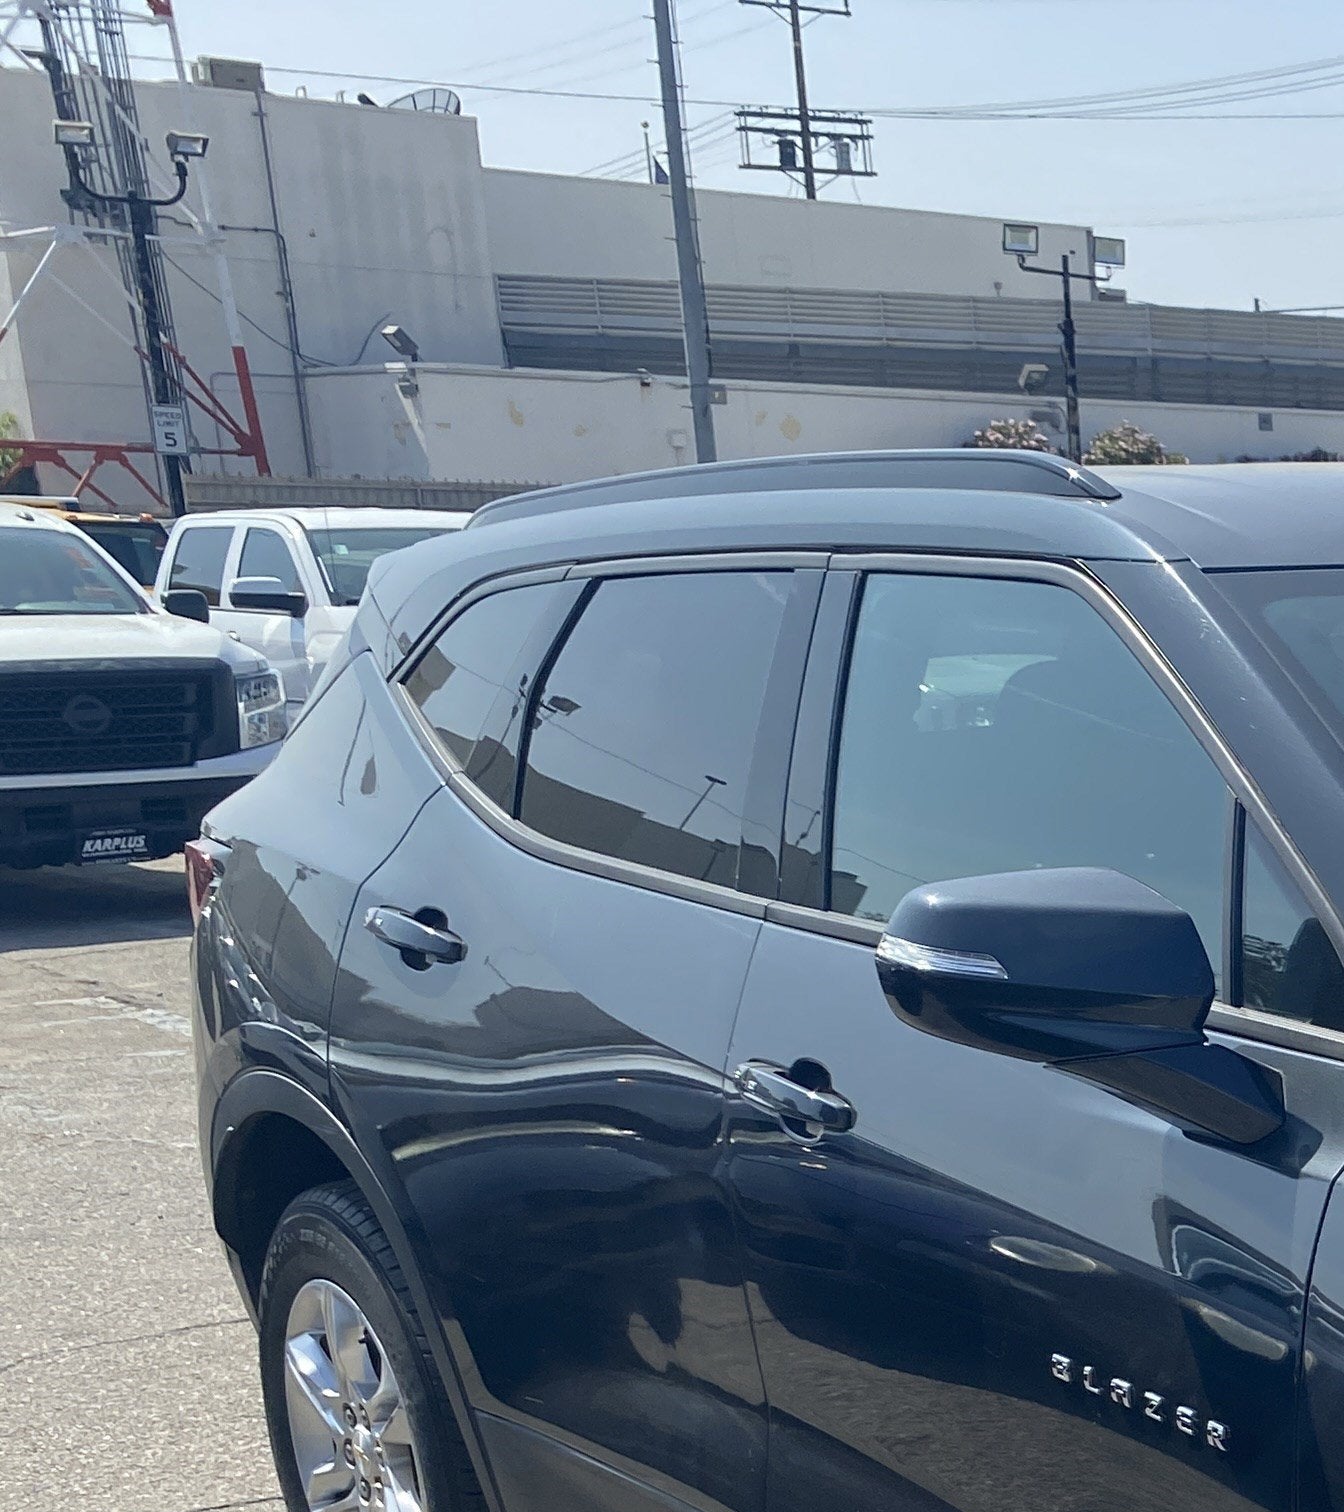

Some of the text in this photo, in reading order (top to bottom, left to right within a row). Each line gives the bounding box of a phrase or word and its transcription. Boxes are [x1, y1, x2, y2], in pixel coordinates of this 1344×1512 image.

[153, 410, 182, 420] SPEED
[156, 419, 180, 428] LIMIT
[163, 431, 178, 447] 5
[82, 834, 147, 852] KARPLUS
[1050, 1352, 1232, 1453] BLAZER
